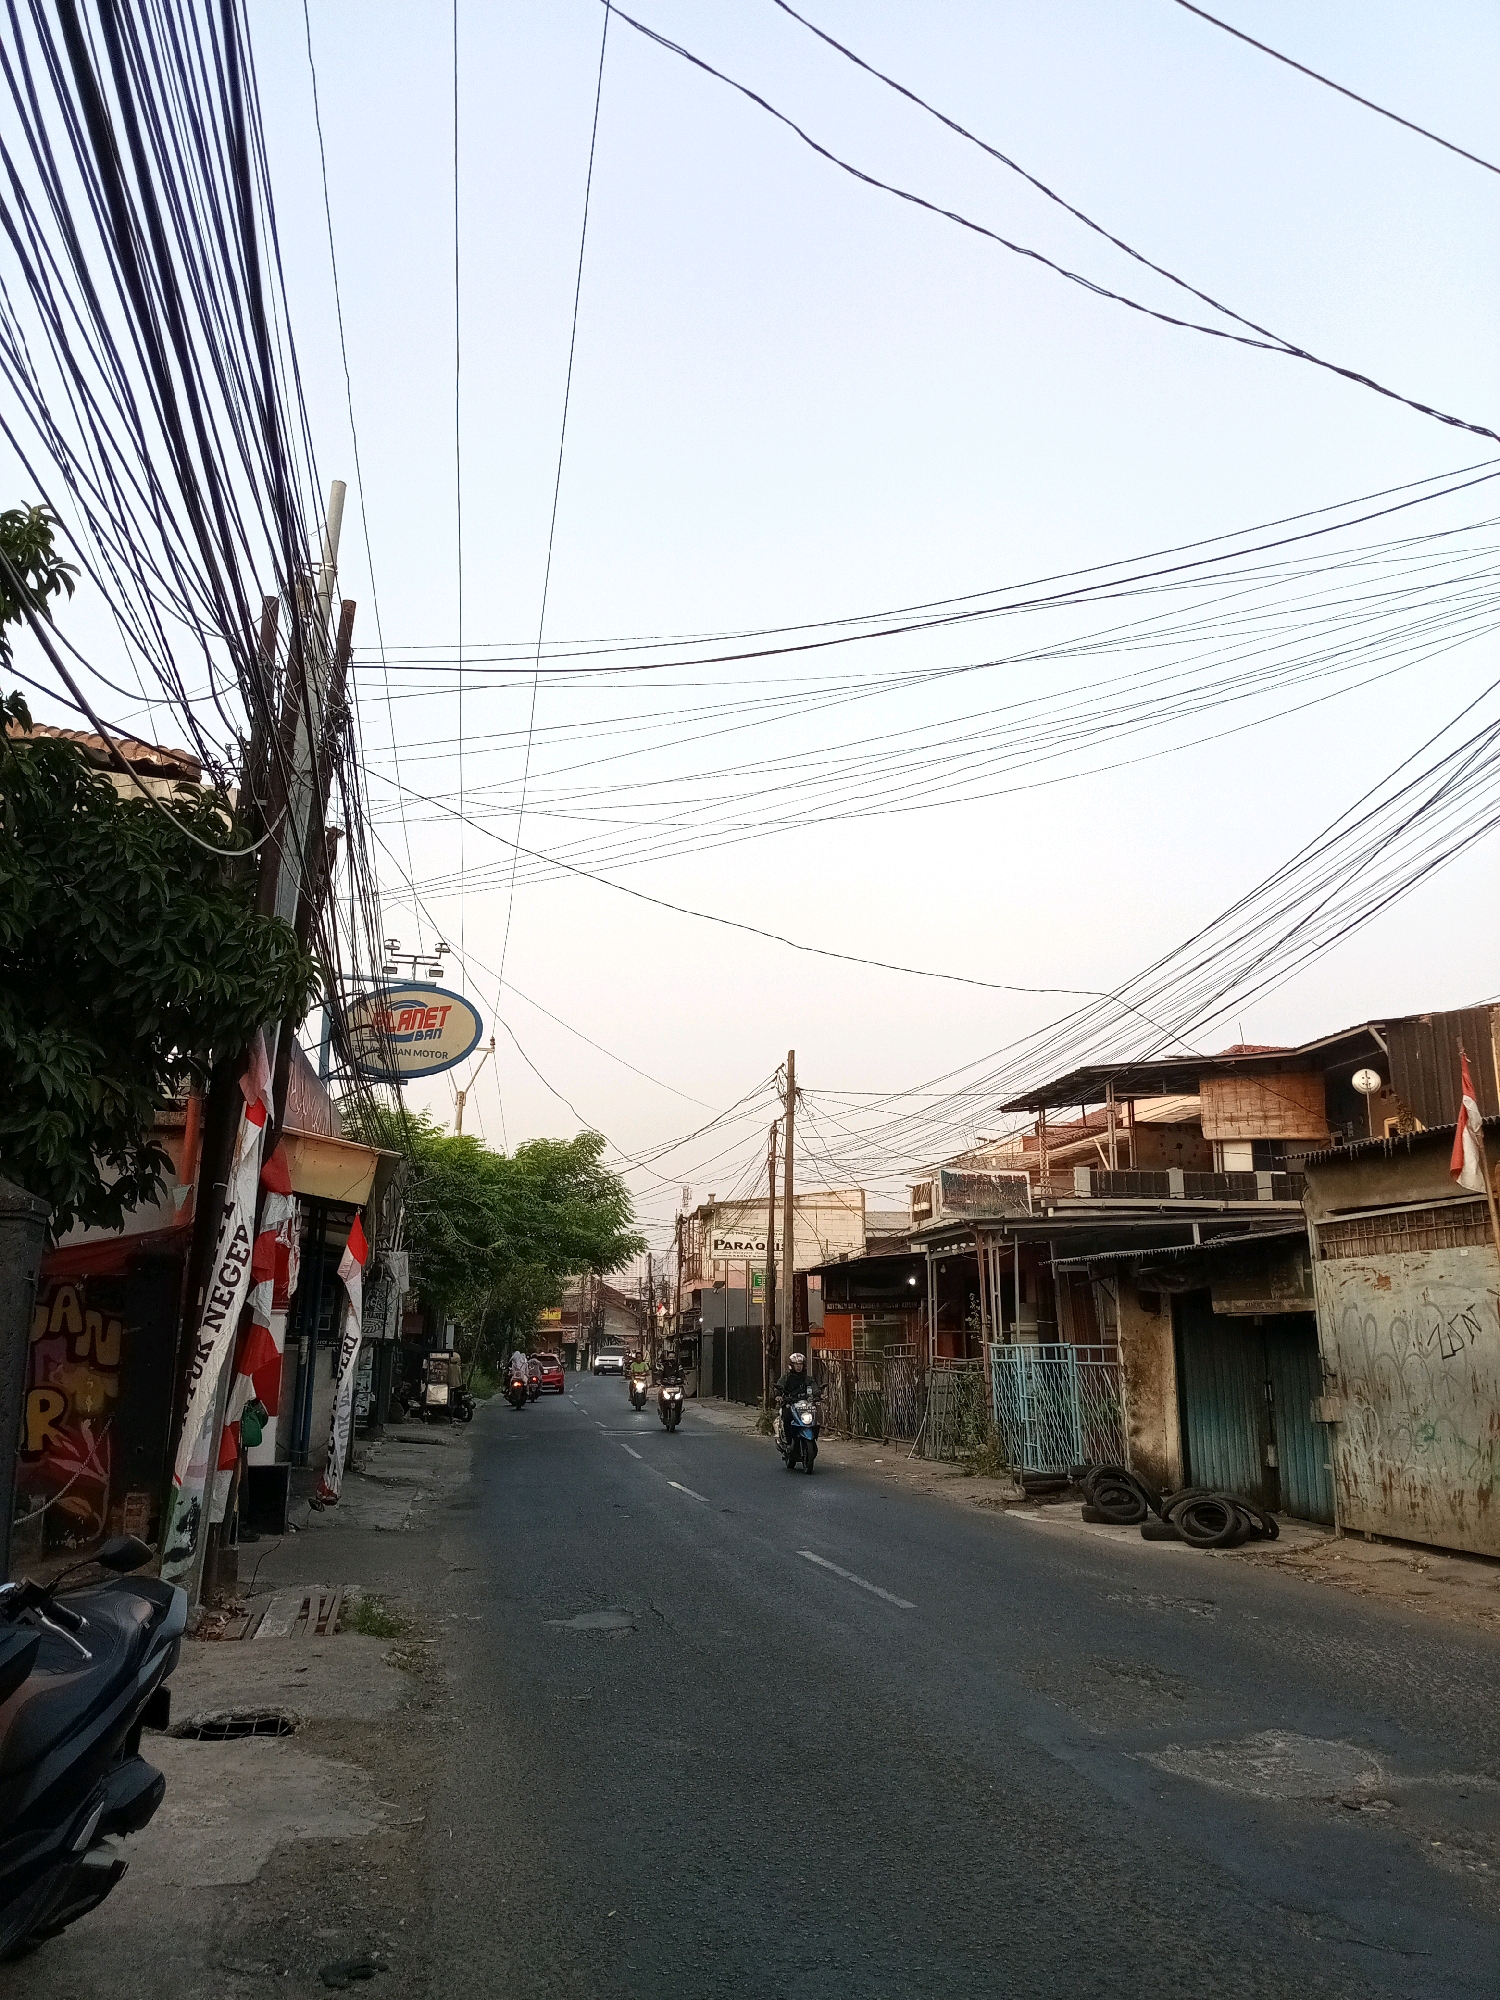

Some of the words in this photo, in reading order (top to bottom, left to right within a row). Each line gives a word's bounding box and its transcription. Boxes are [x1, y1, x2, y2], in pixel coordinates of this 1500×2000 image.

[372, 1005, 453, 1033] PLANET
[414, 1028, 444, 1042] BAN
[413, 1049, 449, 1060] MOTOR
